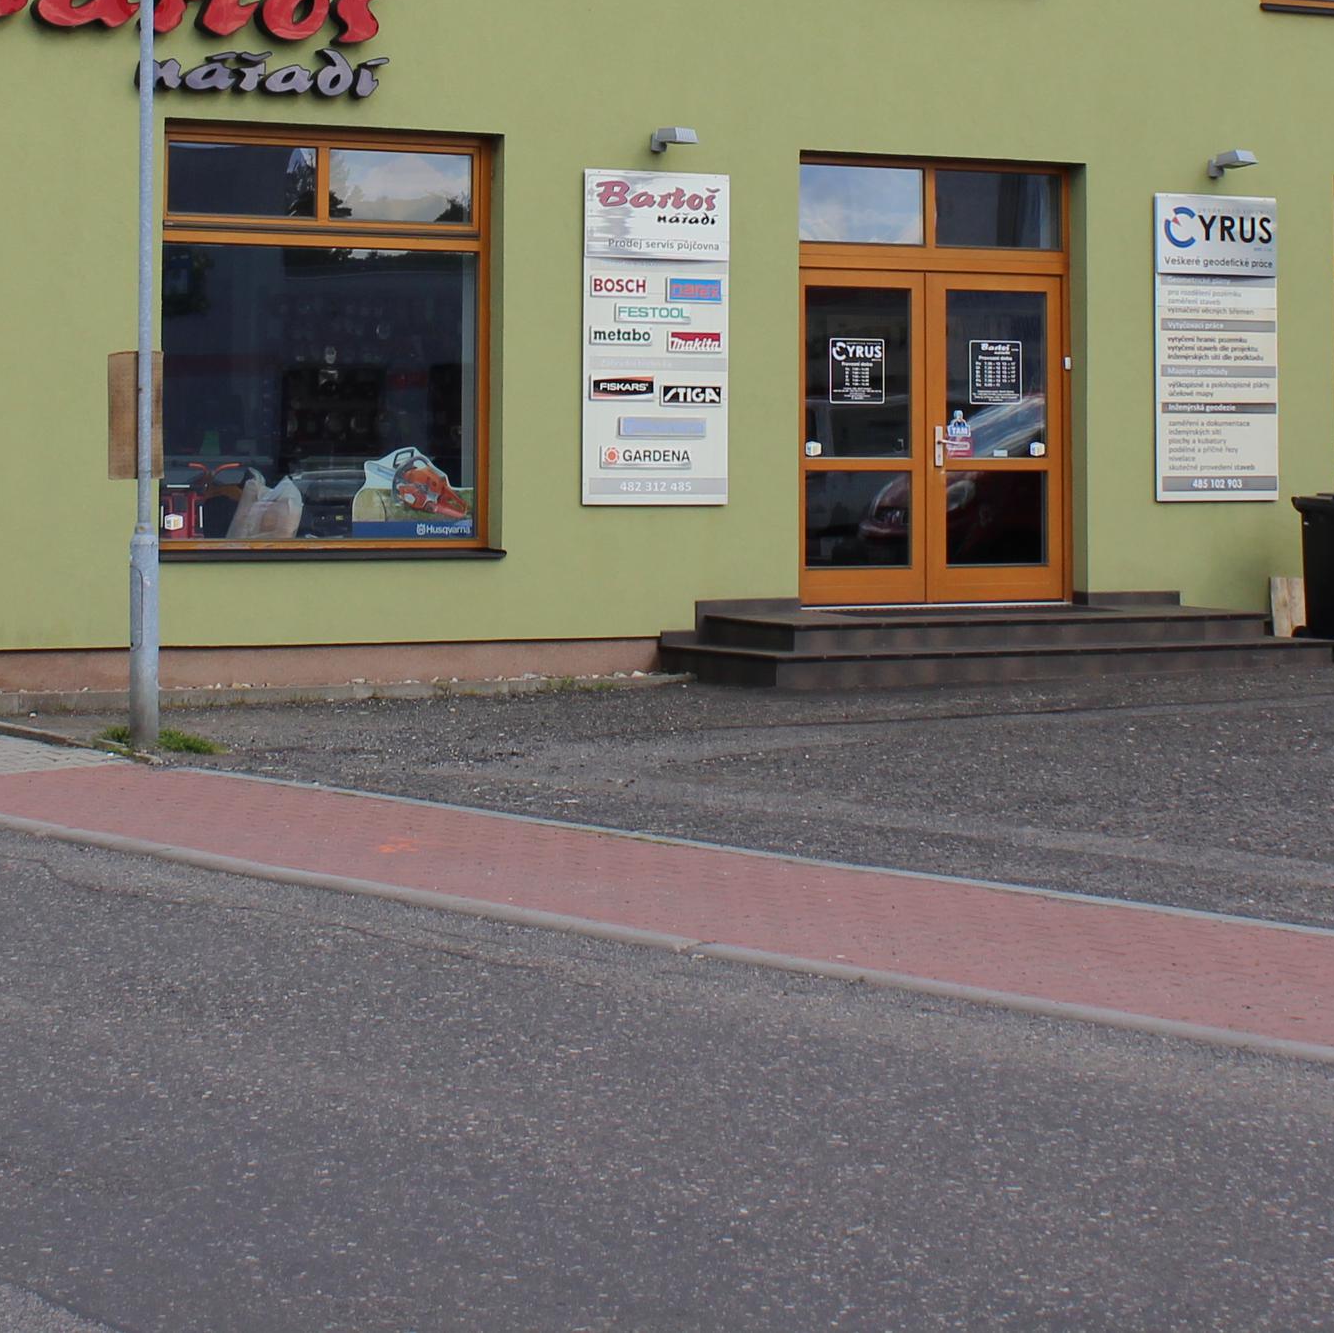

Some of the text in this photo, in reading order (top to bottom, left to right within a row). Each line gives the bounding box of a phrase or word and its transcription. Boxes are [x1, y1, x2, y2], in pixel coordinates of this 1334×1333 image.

[135, 48, 390, 99] nářadí
[595, 180, 721, 212] Bartoš
[657, 213, 719, 226] nářadí
[1164, 207, 1273, 248] CYRUS
[608, 238, 720, 252] Prodej servis půjčovna
[1164, 256, 1274, 268] Veškeré geodetické práce
[593, 278, 646, 294] BOSCH
[618, 306, 690, 319] FESTOOL
[593, 329, 651, 342] metabo
[832, 341, 883, 361] CYRUS
[599, 383, 720, 403] FISKARS STIGA
[623, 450, 690, 462] GARDENA
[620, 481, 692, 492] 482 312 485
[1192, 479, 1243, 489] 485 102 903
[426, 524, 471, 535] Husqvarna
